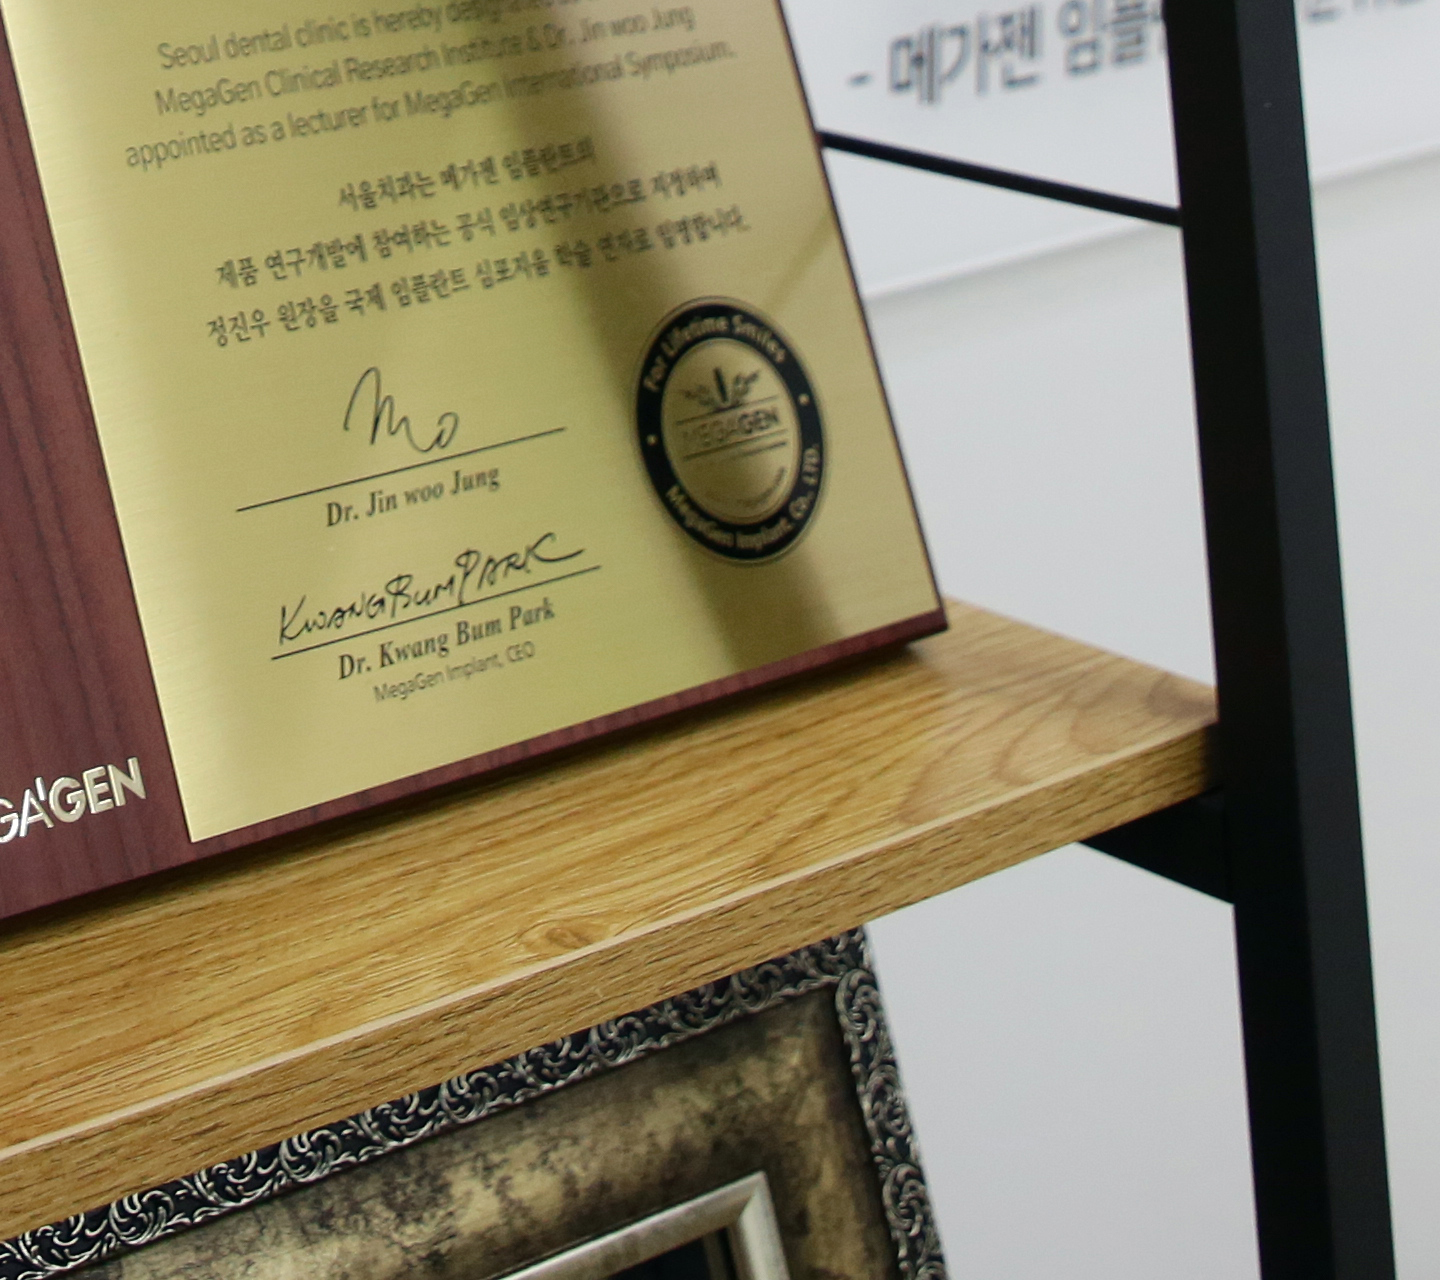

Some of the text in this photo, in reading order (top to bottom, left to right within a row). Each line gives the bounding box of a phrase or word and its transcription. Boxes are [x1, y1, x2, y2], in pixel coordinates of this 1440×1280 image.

[889, 6, 1045, 102] 메가젠
[326, 468, 501, 528] Dr. Jin woo Jung
[339, 597, 556, 680] Dr. Kwang Bum Park
